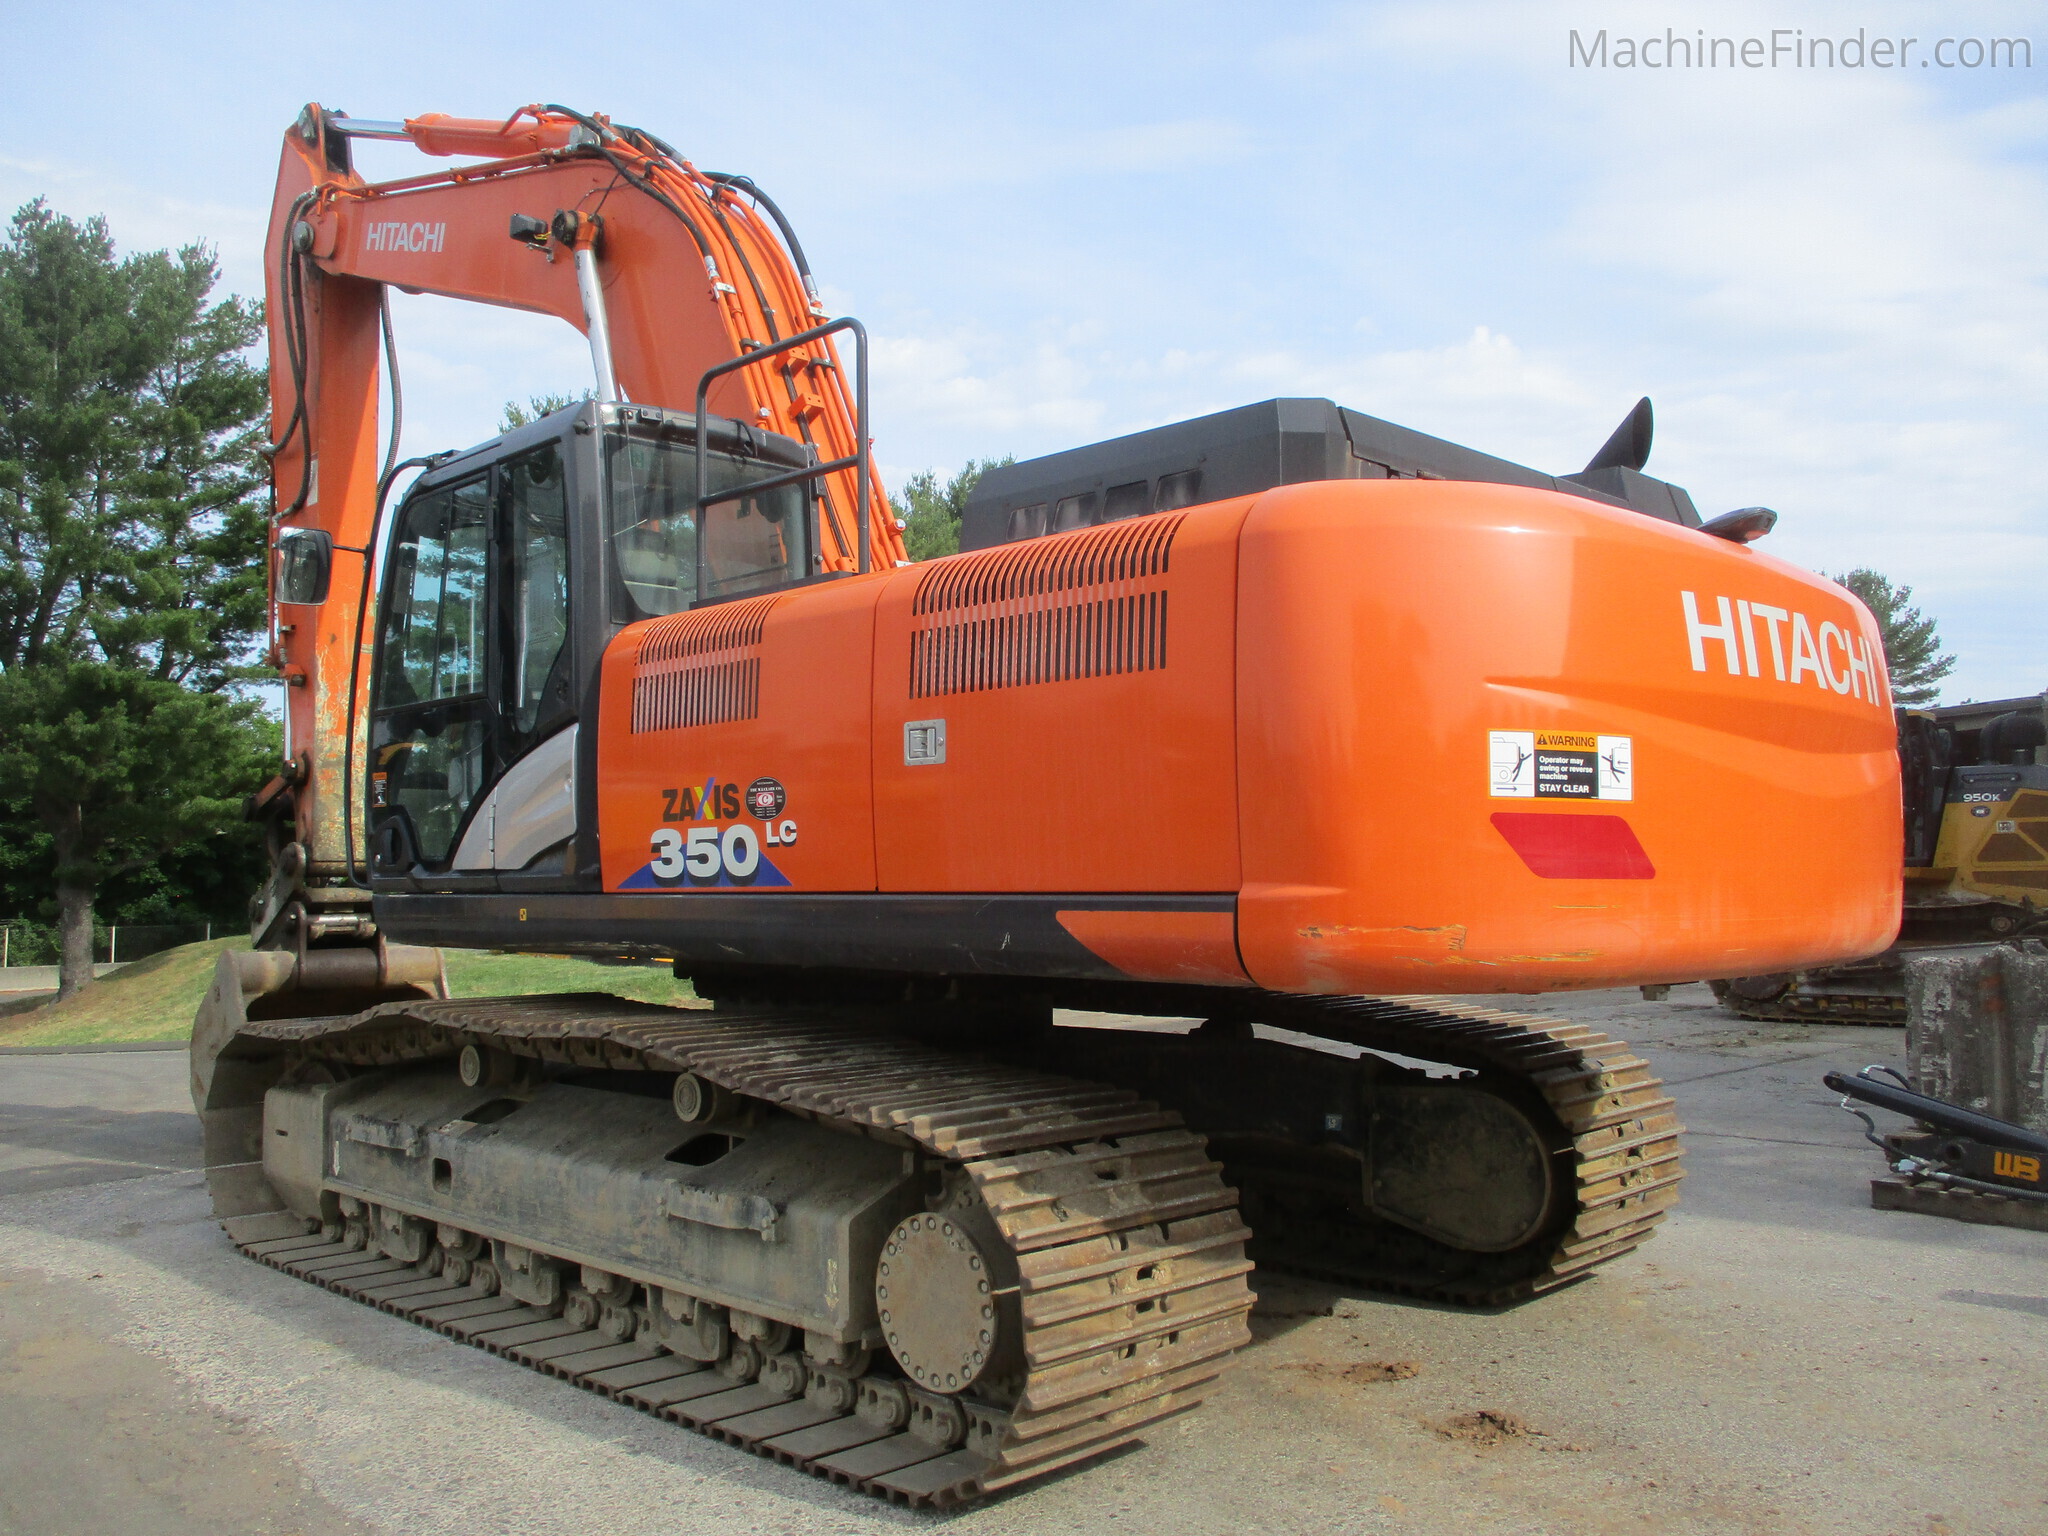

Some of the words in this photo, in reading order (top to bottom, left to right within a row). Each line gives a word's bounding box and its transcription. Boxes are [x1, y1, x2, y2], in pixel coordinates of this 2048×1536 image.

[366, 222, 446, 252] HITACHI
[1681, 590, 1880, 707] HITACHI
[1548, 735, 1595, 747] WARNING
[1539, 756, 1569, 764] Operator
[1539, 765, 1559, 773] swing
[1539, 784, 1561, 792] STAY
[1562, 785, 1589, 793] CLEAR
[661, 777, 740, 822] ZAXIS
[1963, 792, 2001, 802] 950K
[650, 824, 760, 882] 350
[765, 820, 797, 845] LC
